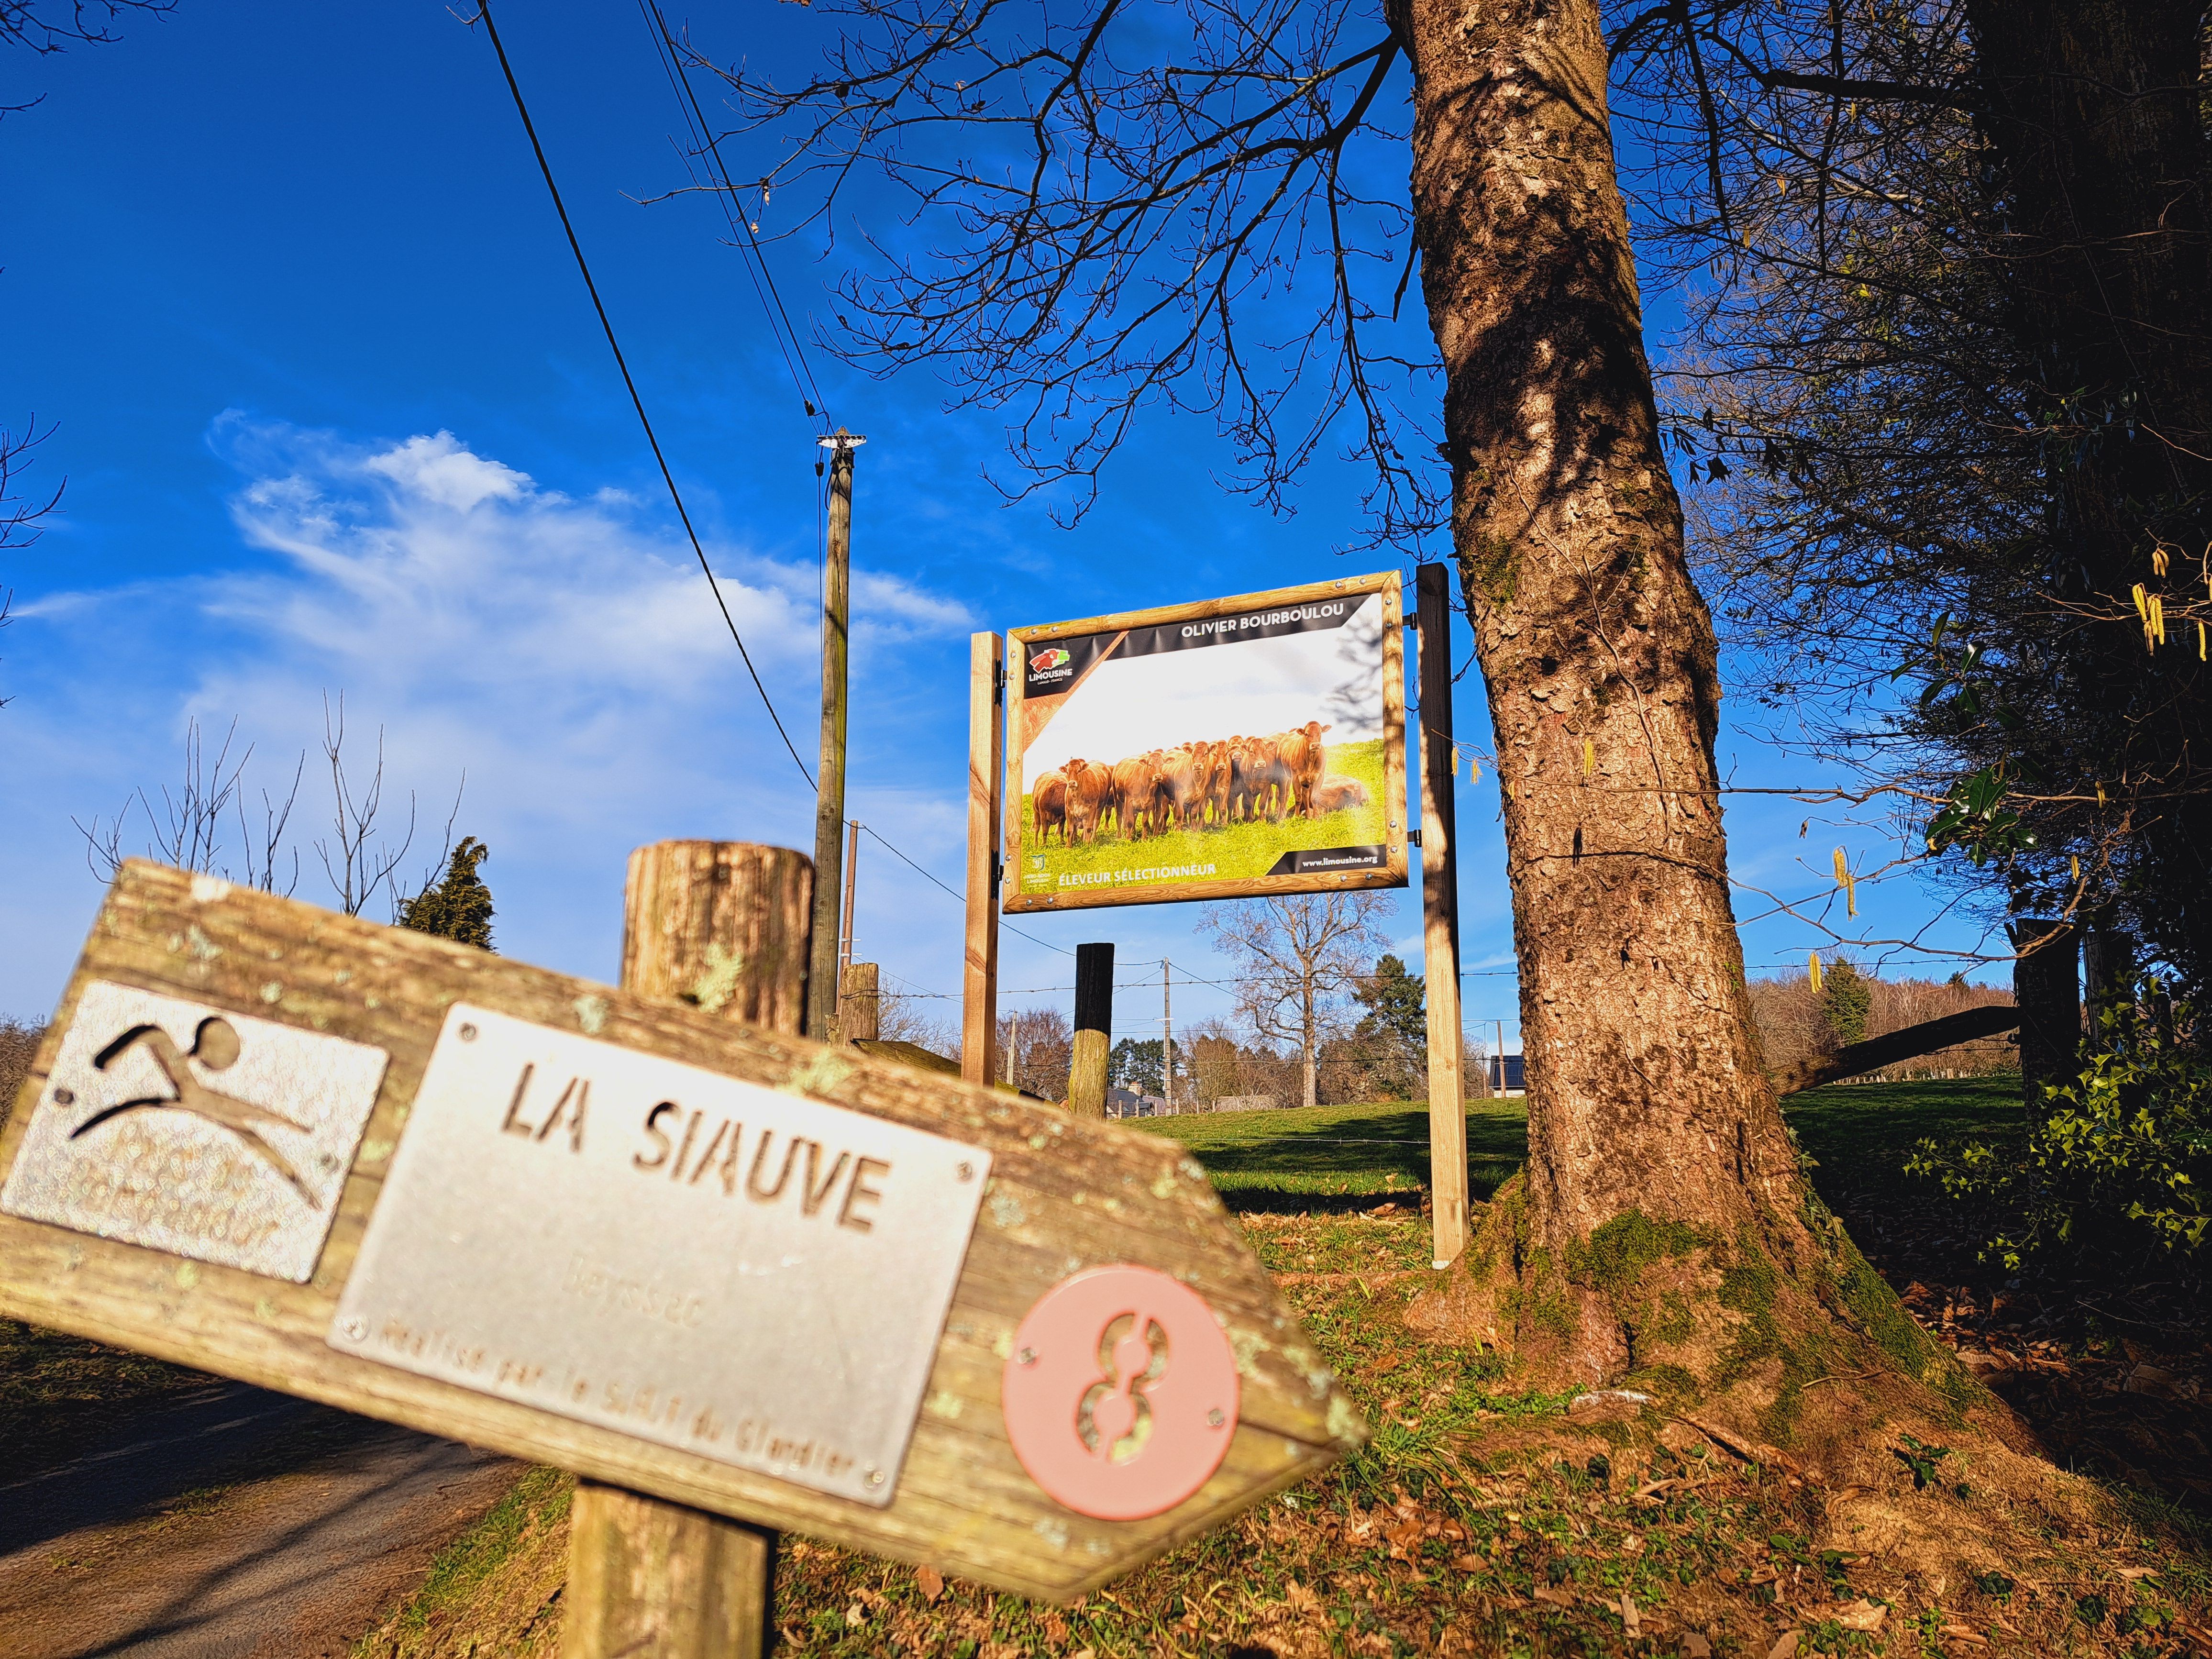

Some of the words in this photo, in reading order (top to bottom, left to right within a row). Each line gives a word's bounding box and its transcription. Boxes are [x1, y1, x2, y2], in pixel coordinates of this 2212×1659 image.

[1182, 619, 1236, 638] OLIVIER
[1240, 603, 1343, 629] BOURBOULOU
[1029, 669, 1073, 682] LIMOUSINE
[1059, 872, 1111, 886] ÉLEVEUR
[1114, 863, 1216, 882] SÉLECTIONNEUR
[1302, 856, 1378, 867] www.limousine.org
[501, 1062, 591, 1153] LA
[633, 1101, 891, 1232] SIAUVE
[1074, 1312, 1169, 1464] 8
